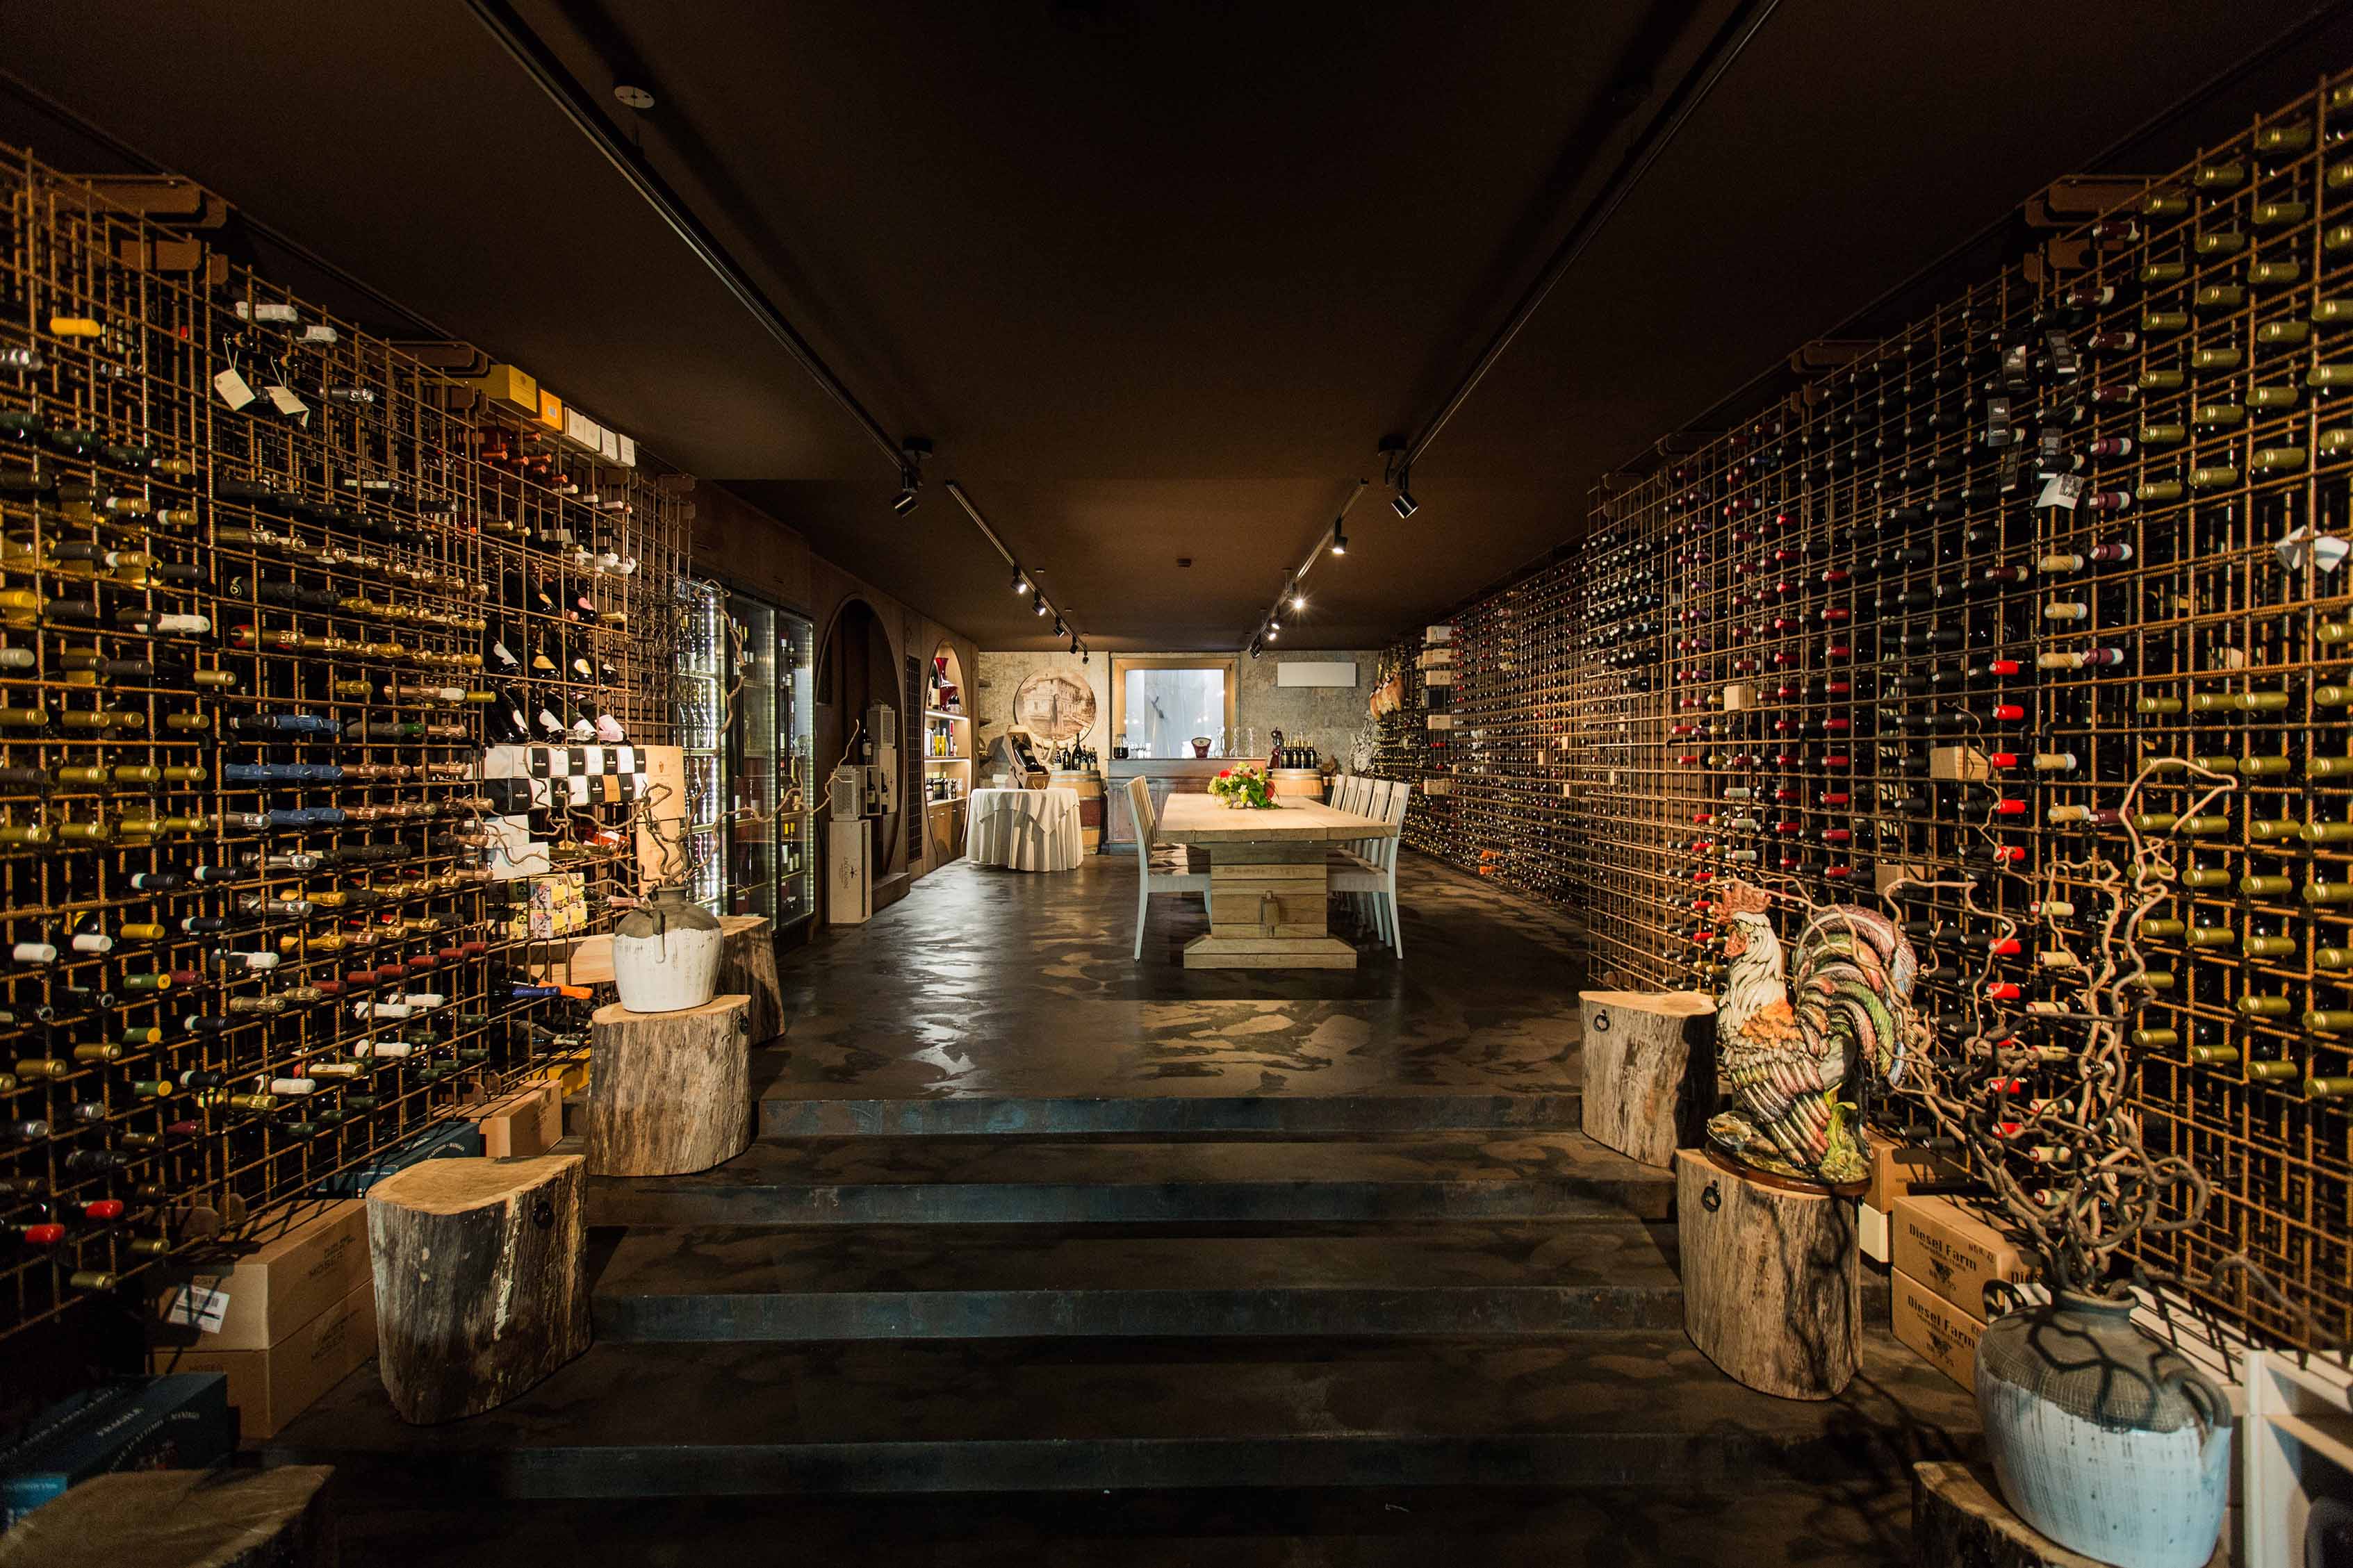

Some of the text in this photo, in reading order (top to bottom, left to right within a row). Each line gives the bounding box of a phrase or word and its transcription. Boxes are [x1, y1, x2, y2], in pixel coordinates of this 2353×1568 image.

[1909, 1223, 1977, 1271] Diesel Farm
[2010, 1270, 2039, 1284] Dies
[1908, 1294, 1976, 1349] Diesel Farm
